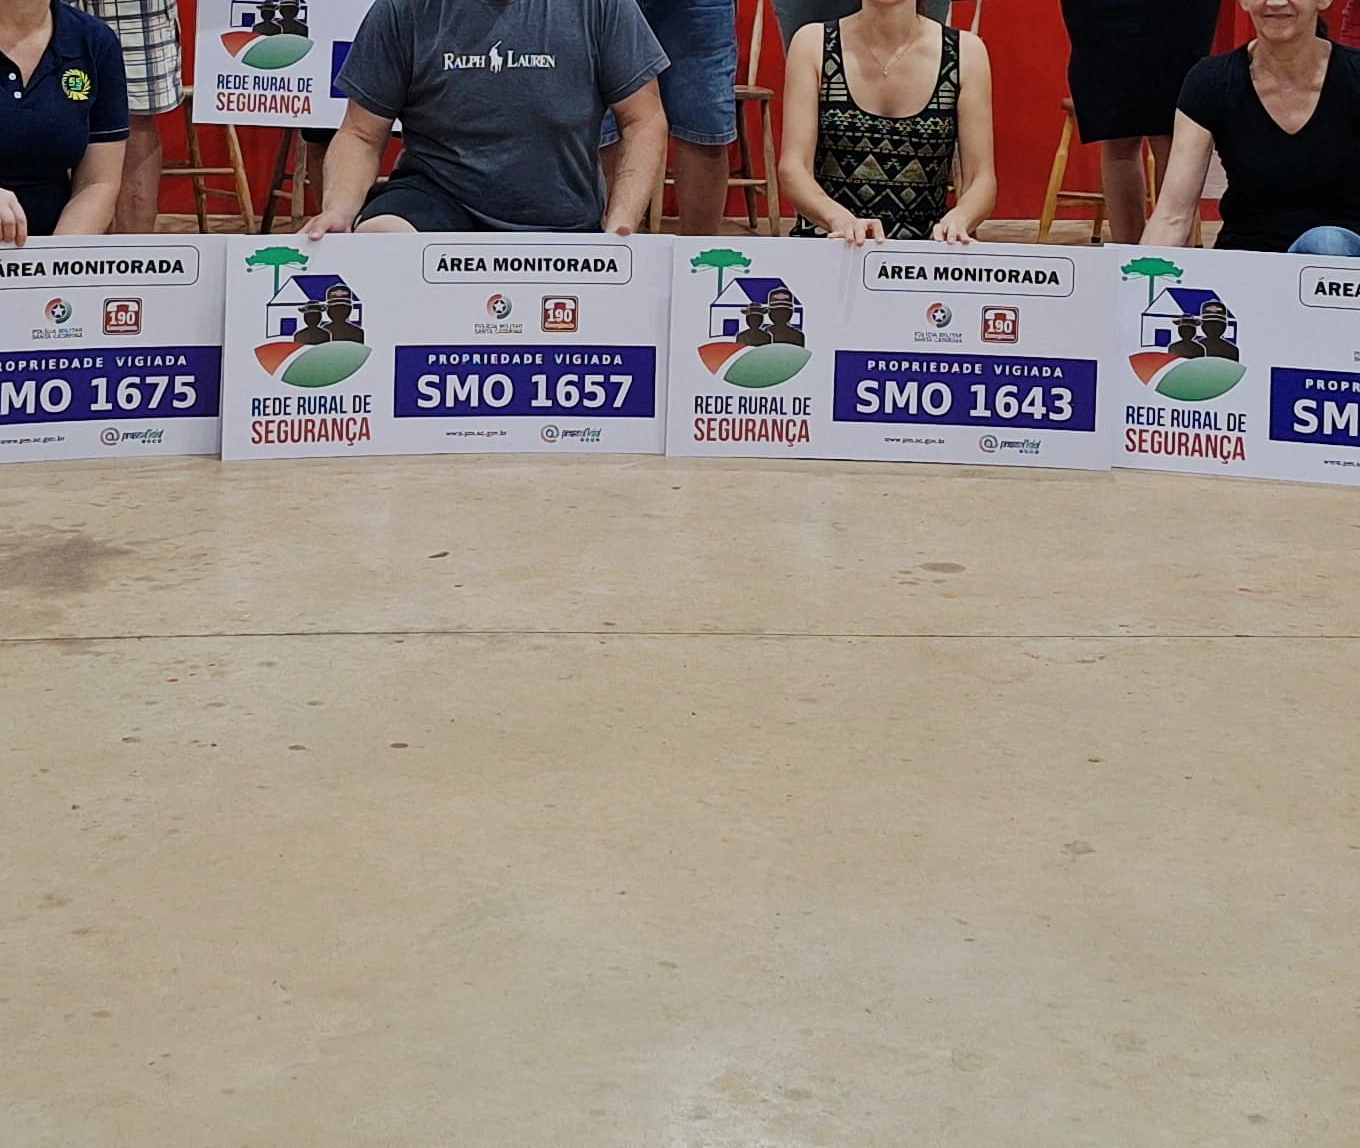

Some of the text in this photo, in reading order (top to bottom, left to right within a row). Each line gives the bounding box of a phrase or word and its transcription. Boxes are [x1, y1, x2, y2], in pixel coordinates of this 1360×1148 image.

[444, 51, 555, 70] RALPH LAUREN
[217, 74, 312, 93] REDE RURAL DE
[216, 92, 311, 117] SEGURANÇA
[53, 260, 184, 275] MONITORADA
[437, 254, 617, 272] ÁREA MONITORADA
[878, 262, 1059, 285] ÁREA MONITORADA
[109, 311, 134, 325] 190
[548, 309, 572, 322] 190
[987, 319, 1012, 333] 190
[116, 356, 186, 366] VIGIADA
[429, 354, 622, 364] PROPRIEDADE VIGIADA
[868, 361, 1062, 377] PROPRIEDADE VIGIADA
[91, 376, 196, 410] 1675
[418, 374, 632, 407] SMO 1657
[857, 380, 1072, 420] SMO 1643
[252, 395, 371, 416] REDE RURAL DE
[695, 396, 811, 415] REDE RURAL DE
[1126, 406, 1246, 432] REDE RURAL DE
[252, 417, 370, 446] SEGURANÇA
[694, 418, 809, 447] SEGURANÇA
[1125, 428, 1245, 464] SEGURANÇA
